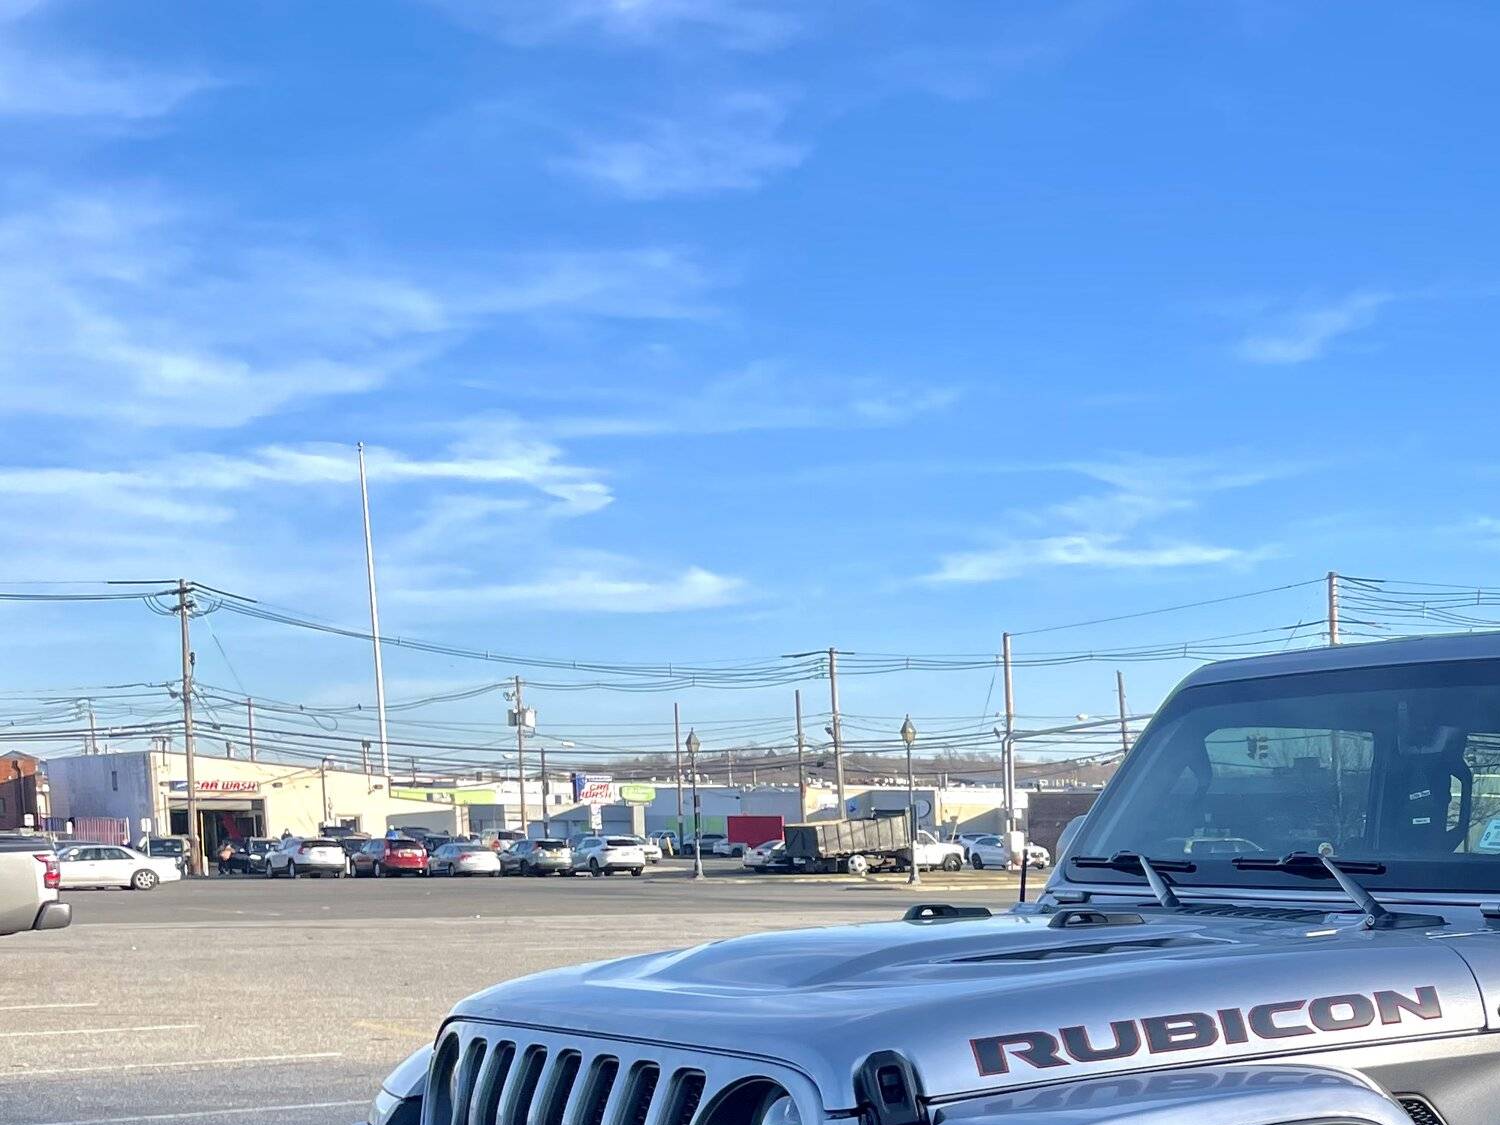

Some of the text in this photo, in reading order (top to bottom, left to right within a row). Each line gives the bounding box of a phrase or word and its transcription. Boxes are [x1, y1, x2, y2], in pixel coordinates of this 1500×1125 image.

[221, 782, 256, 790] WASH
[589, 783, 609, 791] CAR
[580, 790, 612, 799] WASH
[968, 984, 1443, 1077] RUBICON
